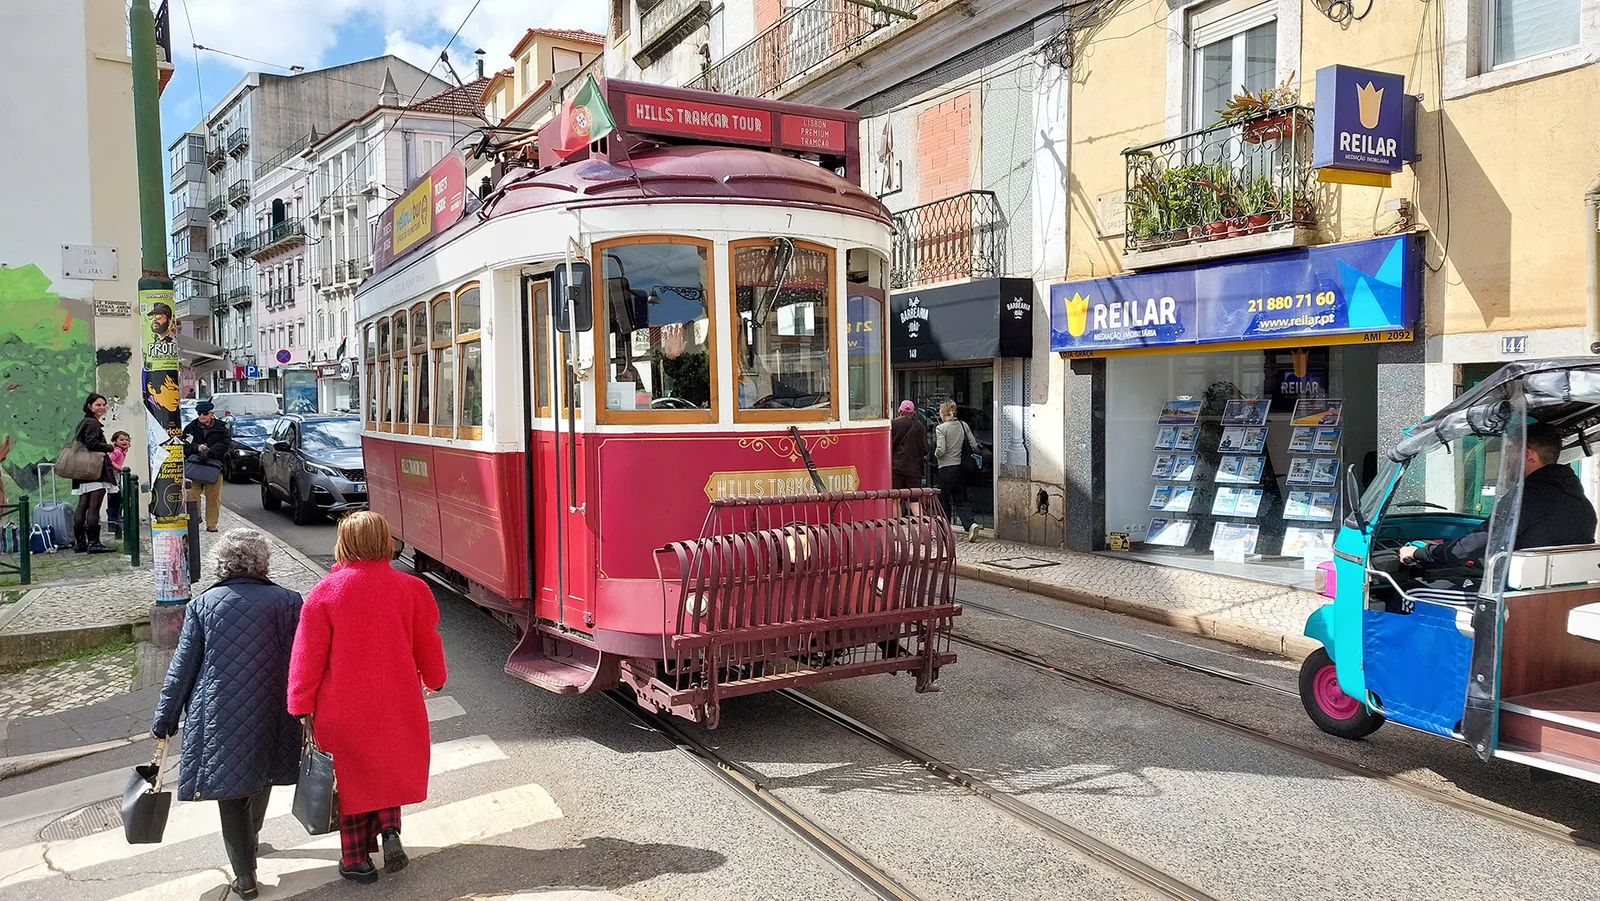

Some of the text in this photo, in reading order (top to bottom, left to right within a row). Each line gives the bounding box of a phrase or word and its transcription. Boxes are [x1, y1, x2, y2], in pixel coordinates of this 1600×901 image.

[635, 103, 763, 132] HILLS TRAMCAR TOUR
[803, 118, 827, 129] LISBON
[801, 128, 829, 138] PREMIUM
[801, 137, 830, 147] TRAMCAR
[1340, 131, 1397, 158] REILAR
[786, 213, 793, 228] 7
[1006, 301, 1031, 311] BARBEARIA
[1248, 291, 1335, 312] 21 880 71 60
[900, 306, 929, 324] BARBEARIA
[1093, 296, 1176, 330] REILAR
[1259, 313, 1335, 329] www.reilar.pt
[1093, 328, 1157, 341] MEDIAÇÃO IMOBILIÁRIA
[1363, 331, 1410, 342] AMI 2092
[1502, 337, 1525, 353] 144
[909, 348, 917, 359] 148
[1281, 381, 1319, 394] REILAR
[717, 479, 764, 498] HILLS
[828, 474, 854, 492] TOUR
